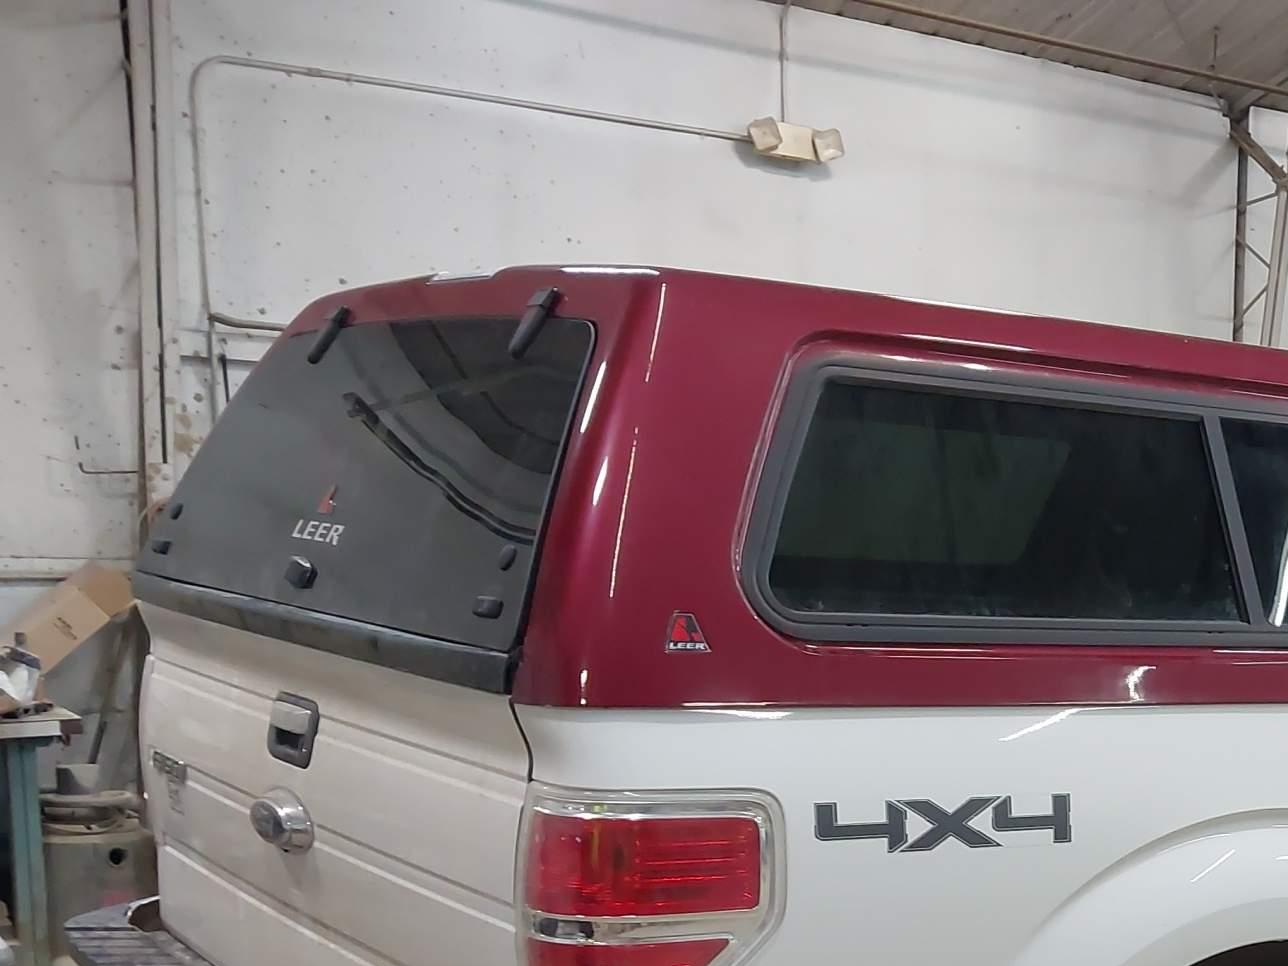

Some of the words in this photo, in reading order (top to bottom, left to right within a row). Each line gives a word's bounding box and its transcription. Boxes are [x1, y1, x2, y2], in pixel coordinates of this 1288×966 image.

[291, 519, 345, 546] LEER
[669, 641, 706, 650] LEER
[813, 792, 1072, 853] 4X4
